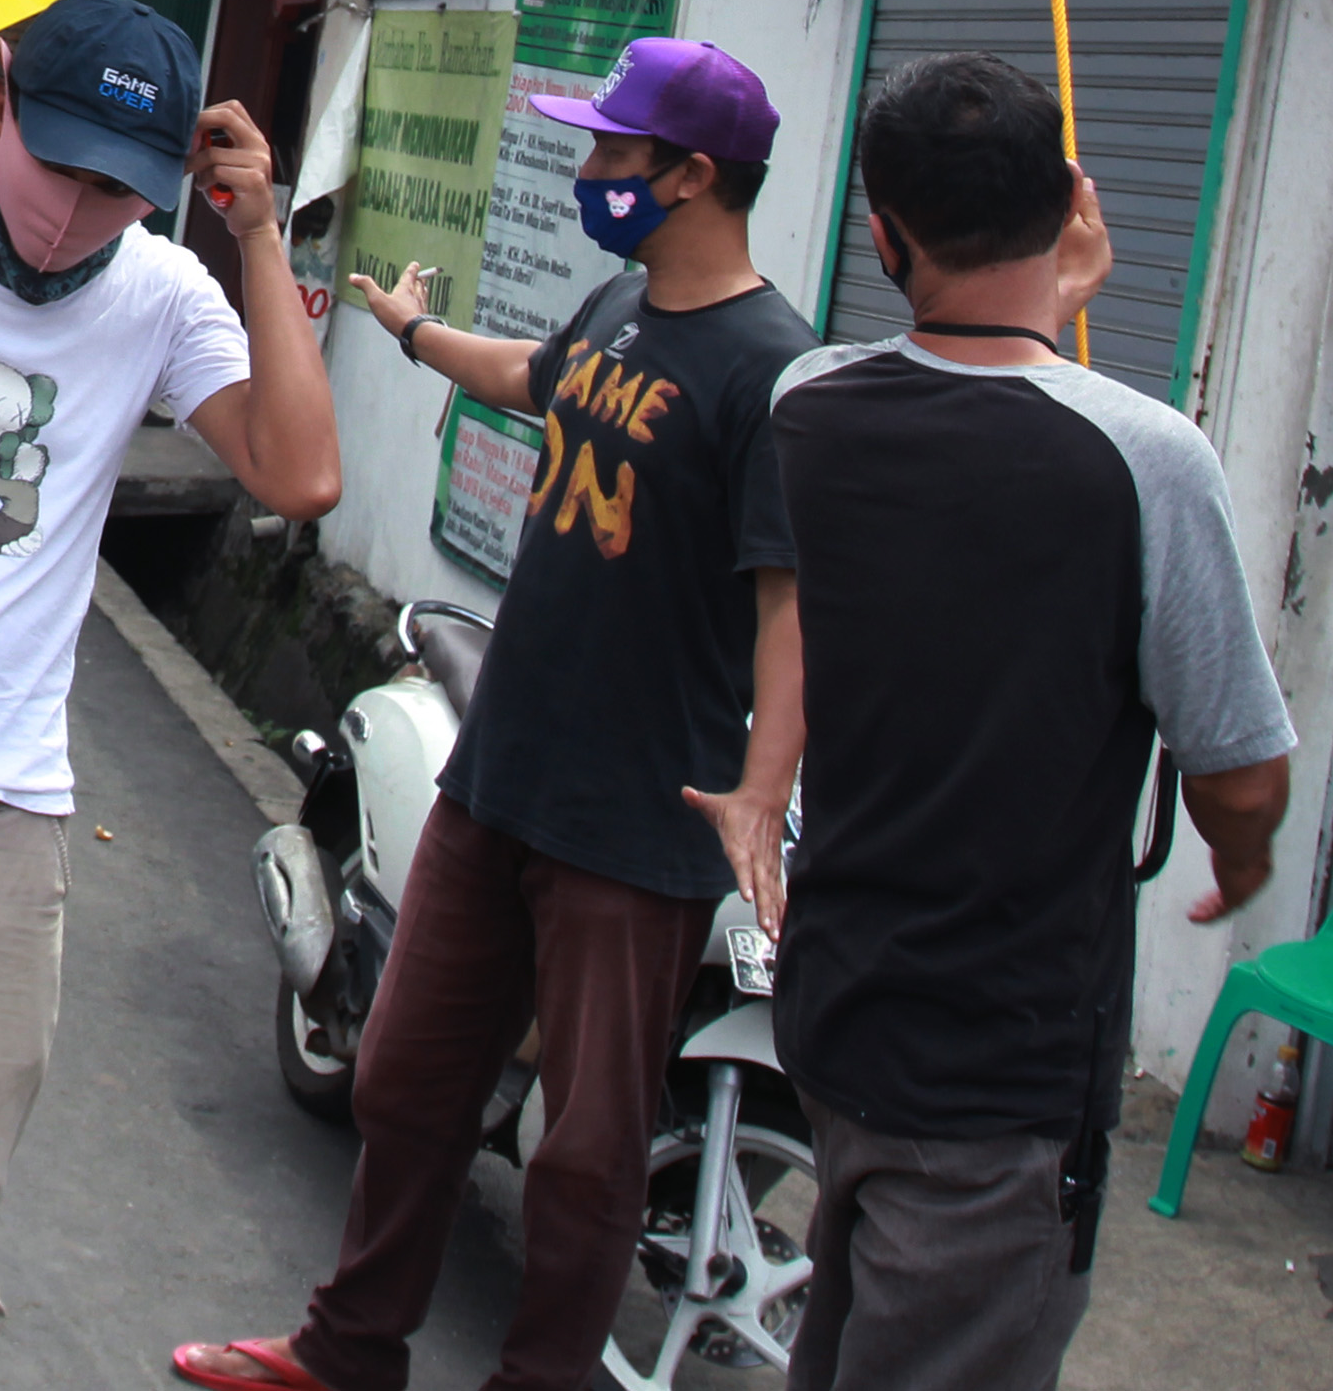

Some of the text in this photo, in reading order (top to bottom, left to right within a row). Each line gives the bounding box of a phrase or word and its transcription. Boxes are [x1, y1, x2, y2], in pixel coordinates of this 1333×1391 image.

[98, 82, 155, 114] OVER
[102, 67, 160, 101] GAME
[401, 174, 442, 228] PUASA
[471, 188, 489, 238] H
